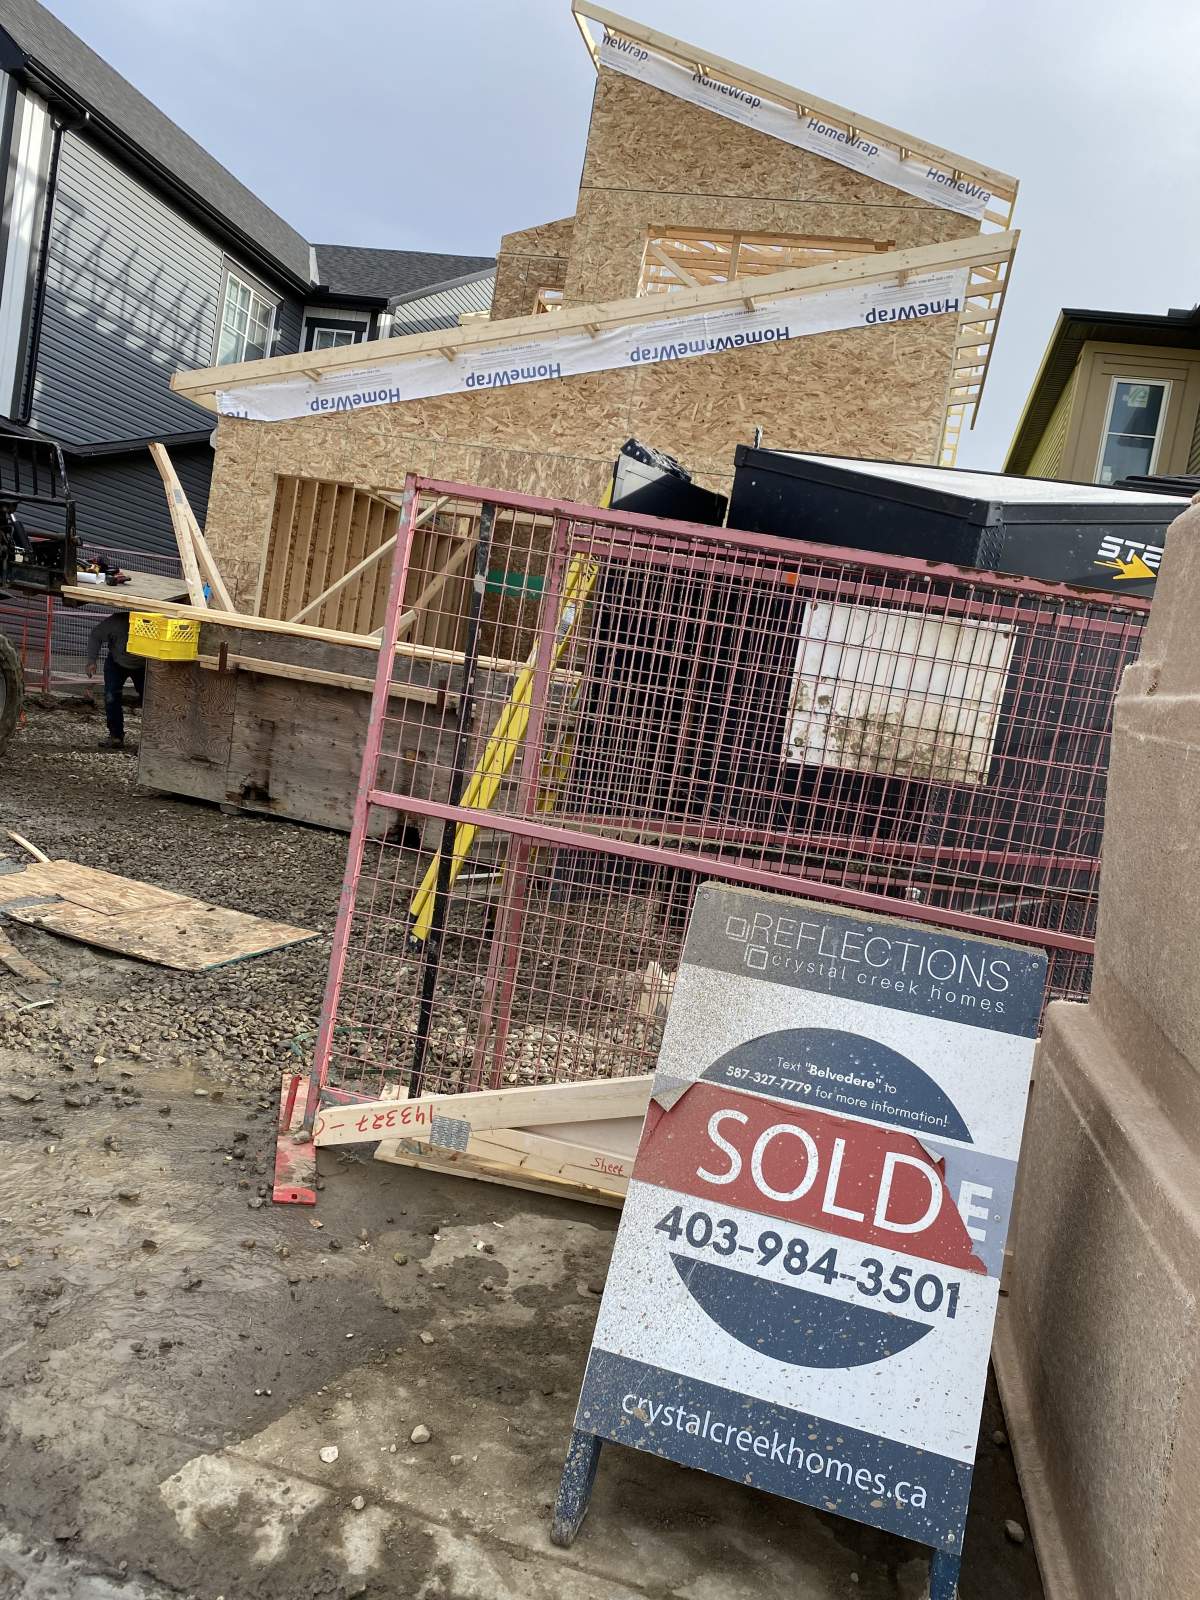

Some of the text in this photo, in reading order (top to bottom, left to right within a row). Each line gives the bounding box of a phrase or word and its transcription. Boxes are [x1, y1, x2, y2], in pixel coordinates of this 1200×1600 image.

[807, 117, 878, 157] HomeWrap
[310, 387, 401, 413] HomeWrap
[465, 362, 562, 389] HomeWrap
[750, 912, 1011, 992] REFLECTIONS
[772, 953, 1005, 1013] crystal creek homes
[725, 1065, 949, 1128] 587-327-7779 for more information!
[777, 1056, 802, 1072] Text
[883, 1082, 897, 1094] to
[696, 1108, 944, 1235] SOLD
[655, 1205, 961, 1319] 403-984-3501
[622, 1393, 928, 1509] crystalcreekhomes.ca
